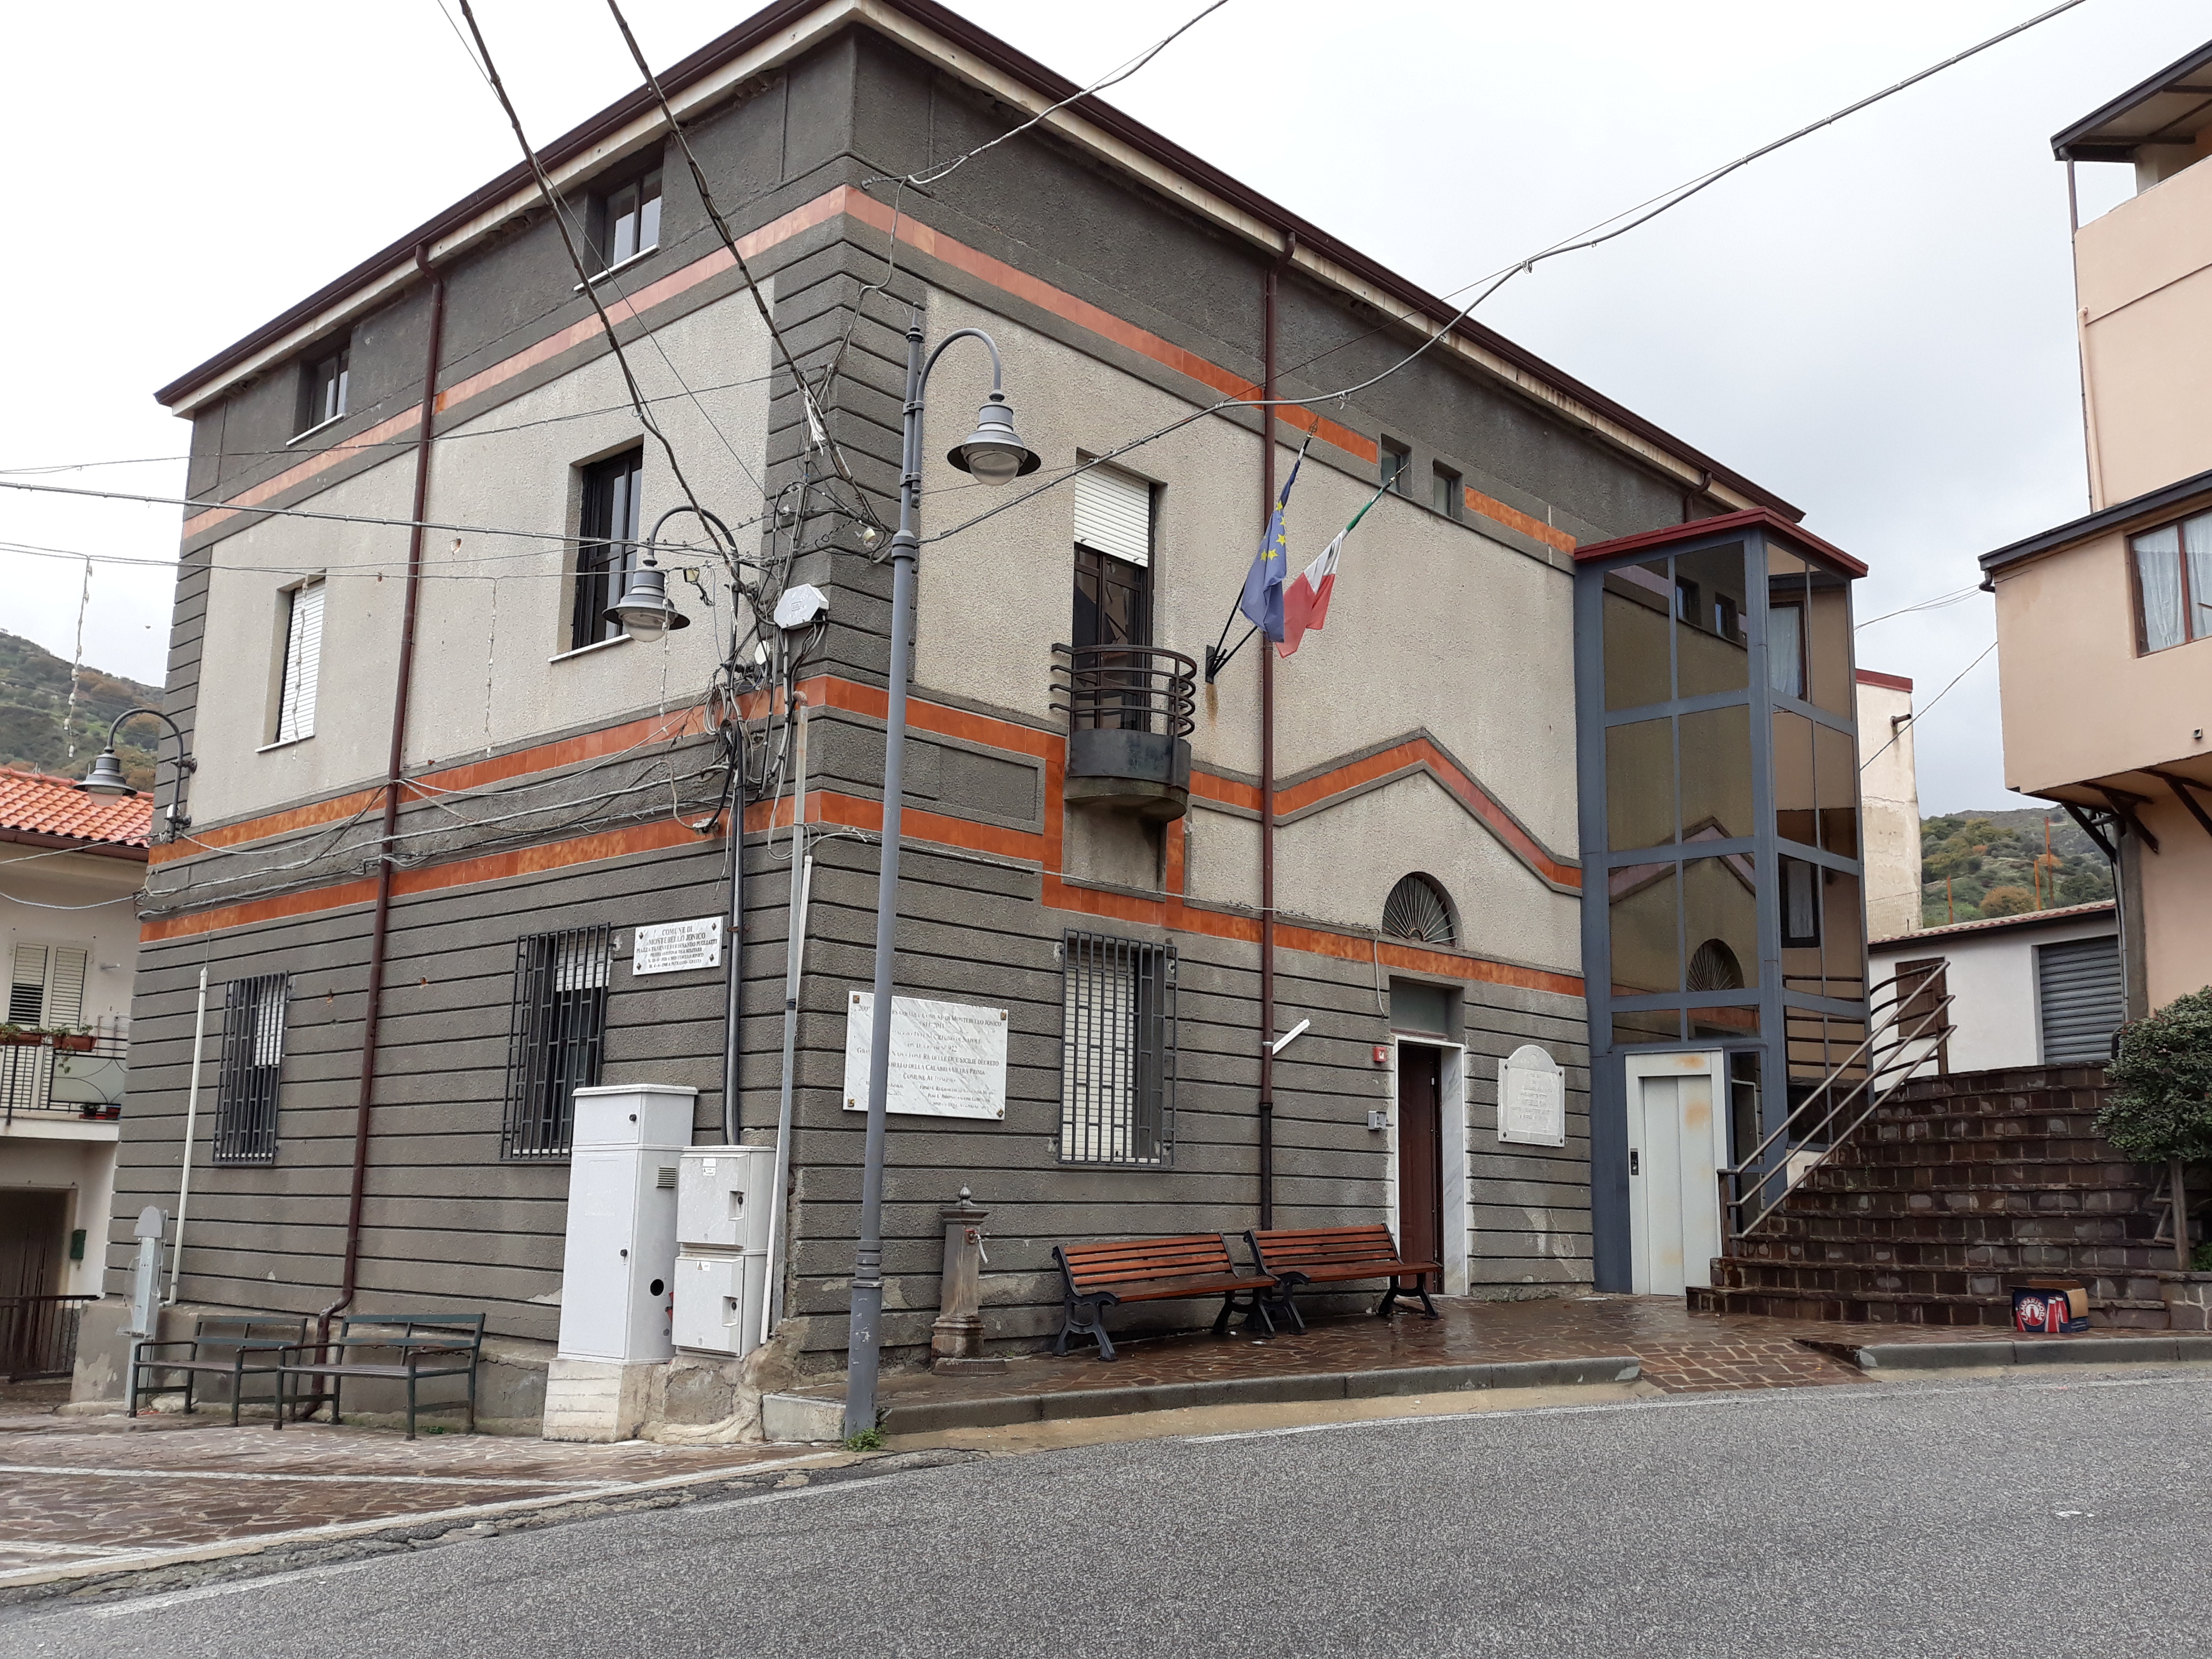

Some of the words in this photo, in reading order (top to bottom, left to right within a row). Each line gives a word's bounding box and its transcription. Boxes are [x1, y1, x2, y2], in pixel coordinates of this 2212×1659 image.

[662, 926, 686, 936] COMUNE
[649, 935, 685, 945] MONTEBELLO
[686, 932, 706, 941] JONICO
[951, 1015, 984, 1025] MONTEBELLO
[960, 1057, 976, 1065] SICILIE
[903, 1073, 925, 1081] COMUNE
